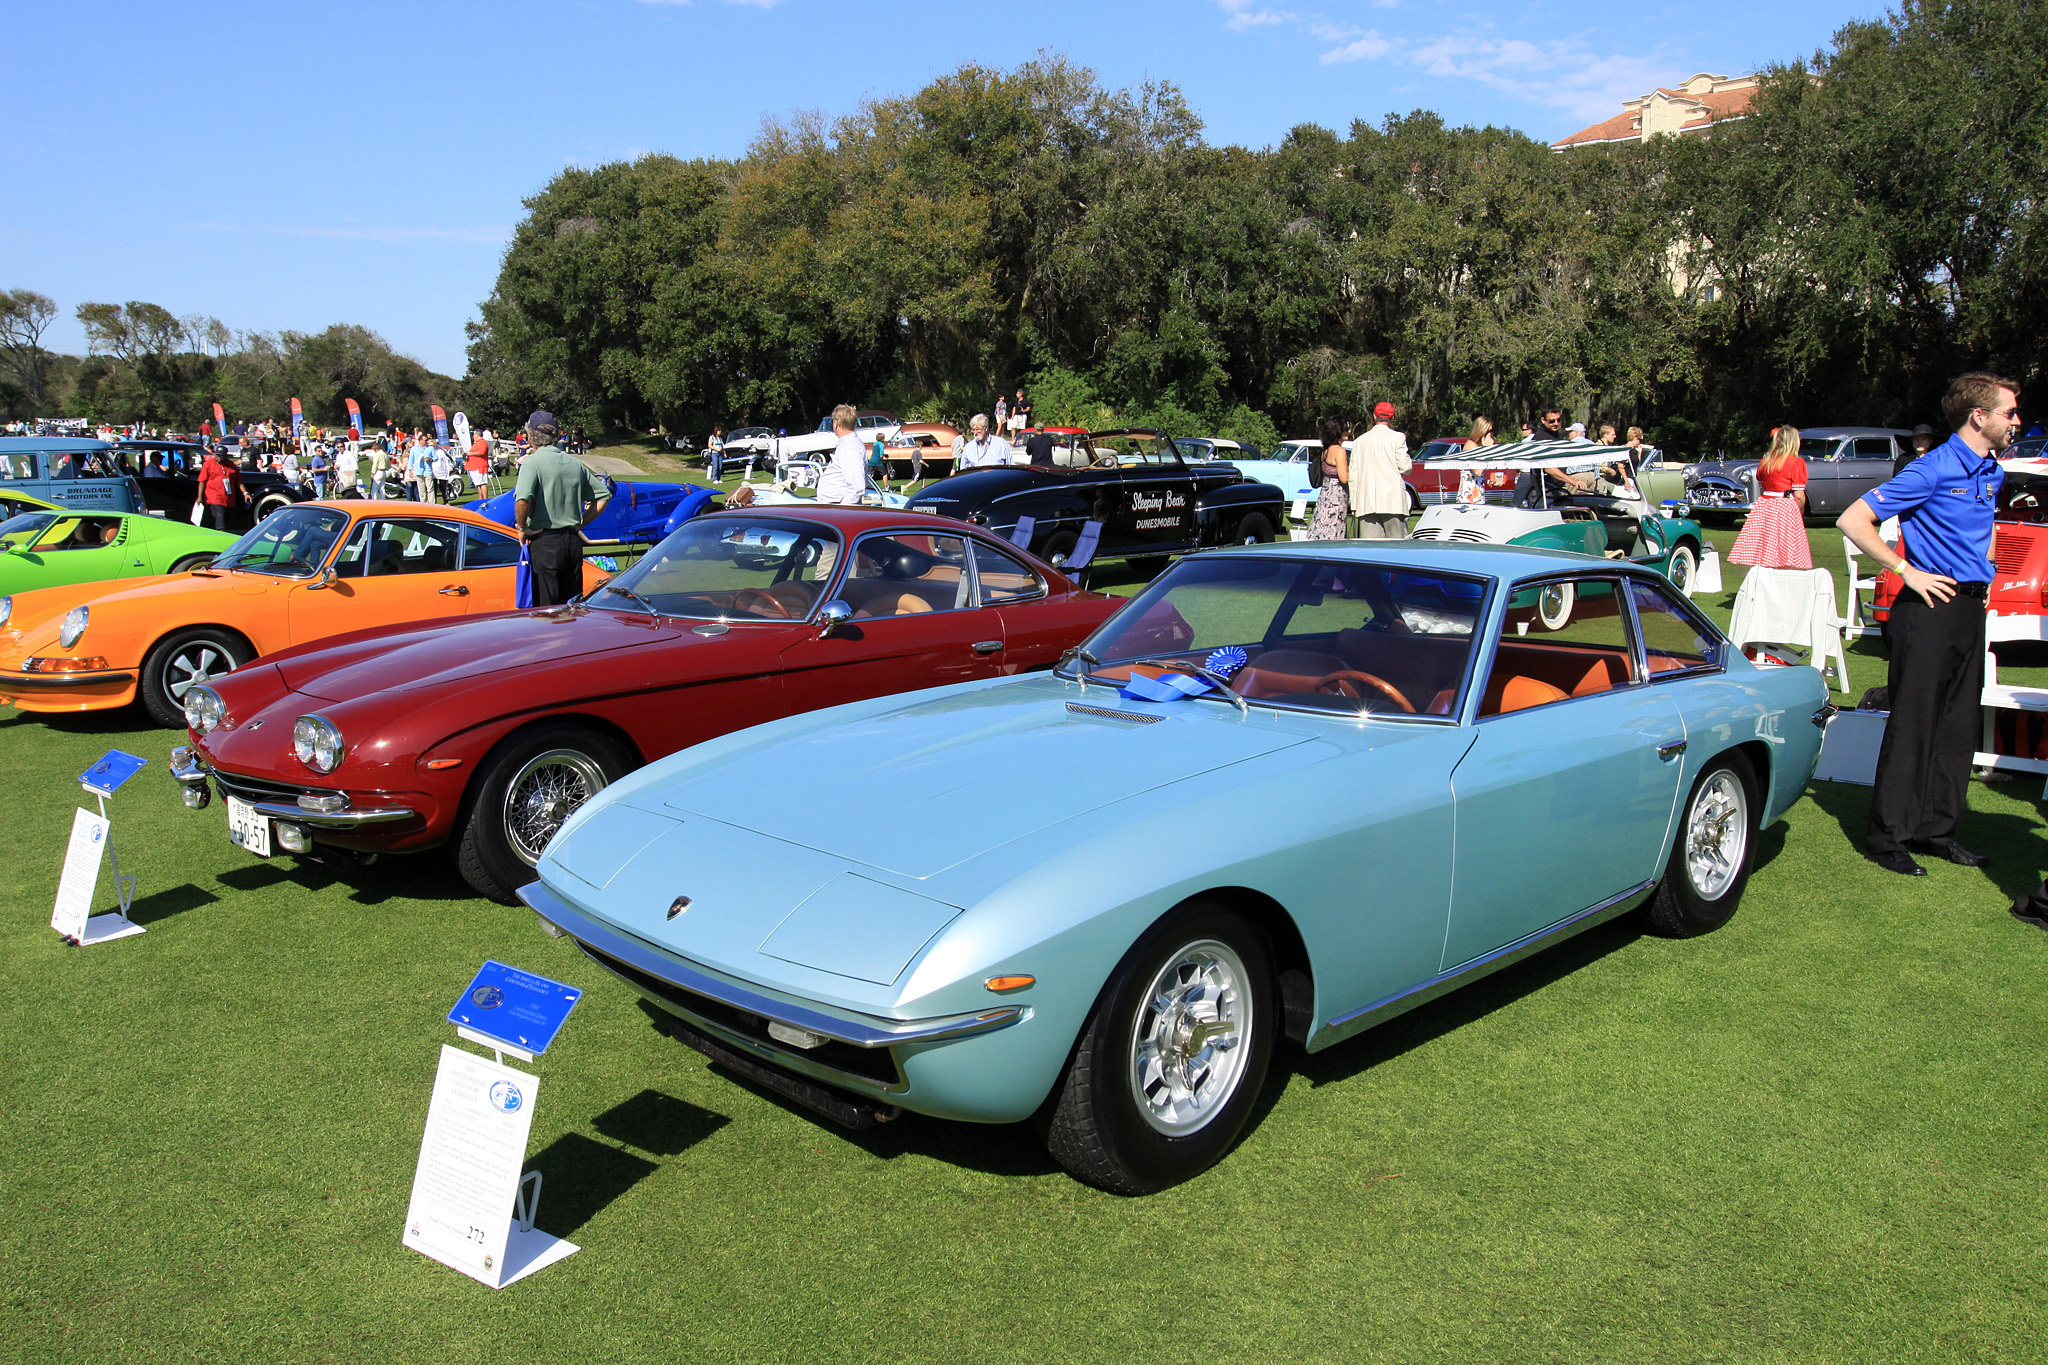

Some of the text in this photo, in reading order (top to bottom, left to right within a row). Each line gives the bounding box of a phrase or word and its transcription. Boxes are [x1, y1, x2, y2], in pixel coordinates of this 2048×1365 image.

[1193, 483, 1197, 491] 9
[1131, 490, 1186, 512] Sleeping Bear
[1135, 516, 1180, 530] DUNESMOBILE
[467, 1225, 485, 1245] 272
